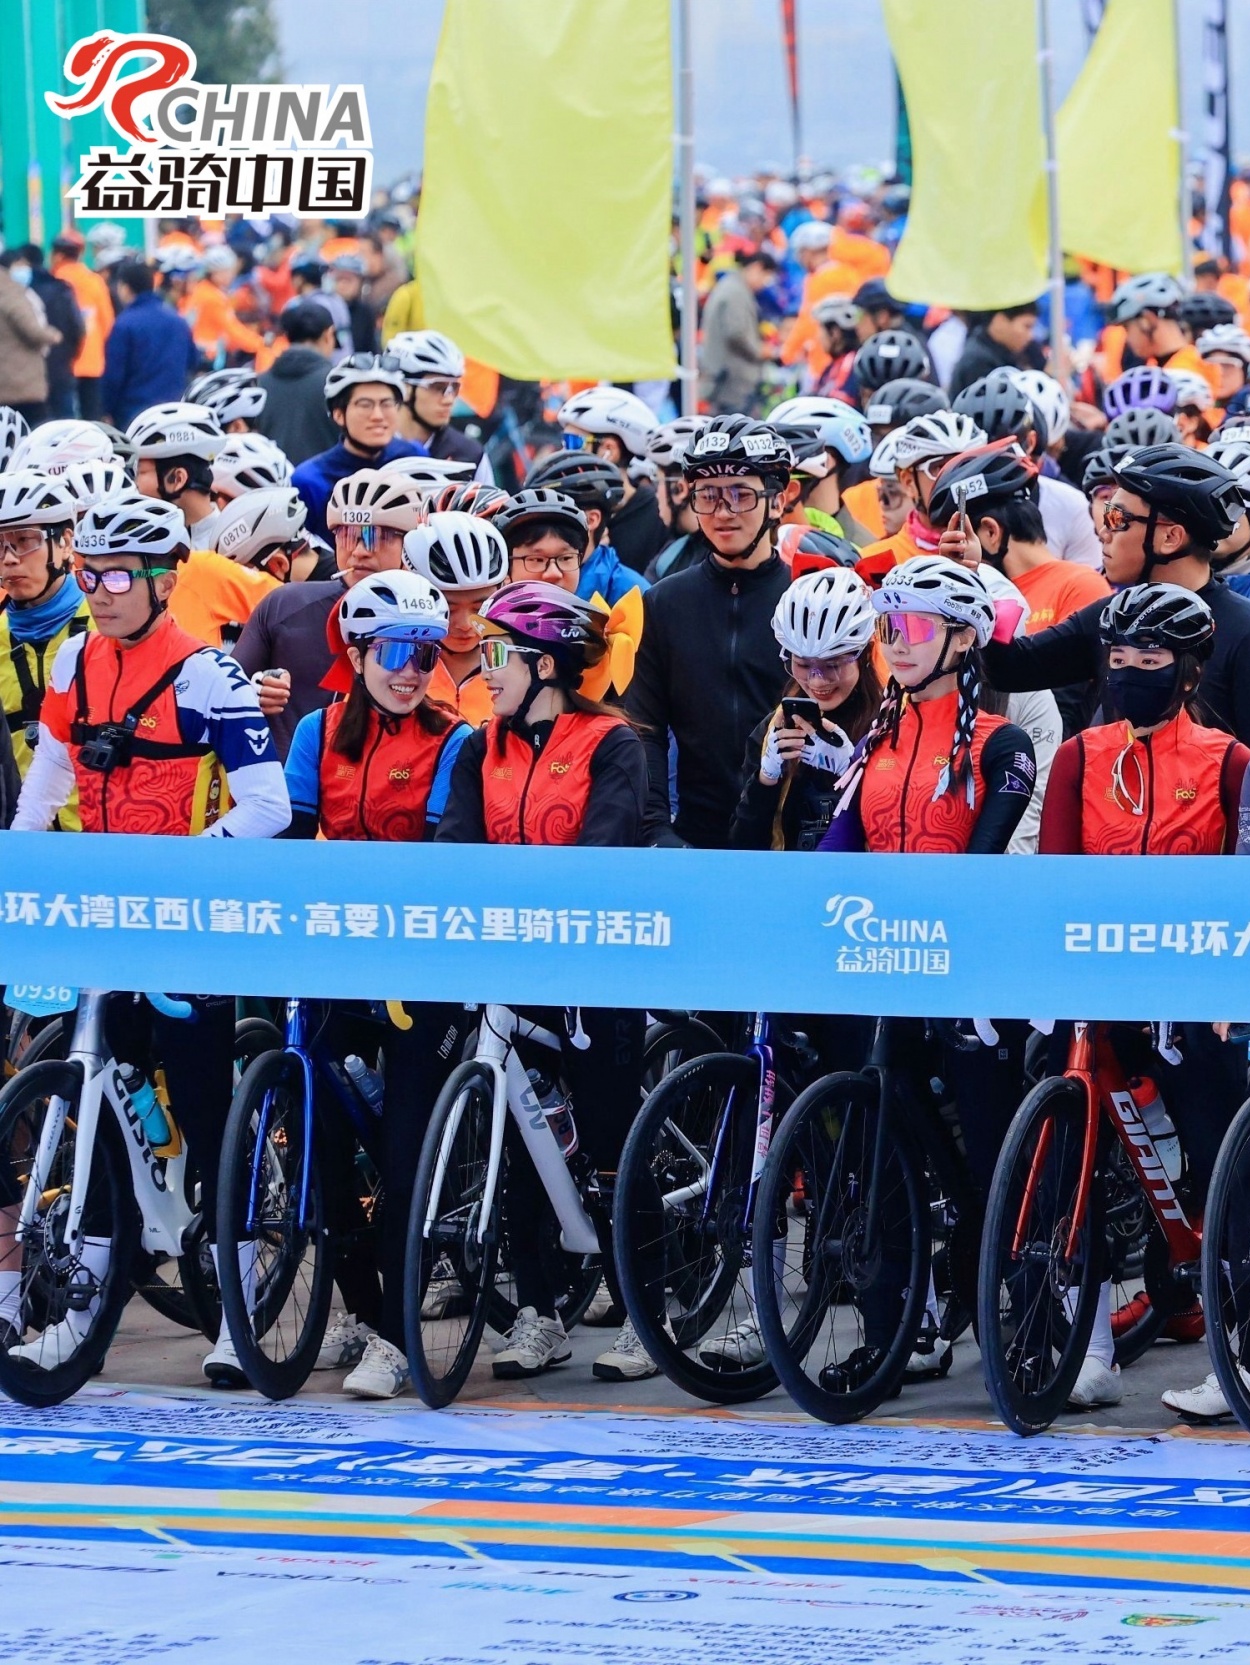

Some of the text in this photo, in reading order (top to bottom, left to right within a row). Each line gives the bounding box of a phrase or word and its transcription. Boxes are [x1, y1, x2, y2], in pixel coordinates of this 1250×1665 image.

[169, 432, 195, 443] 0881
[699, 436, 727, 451] 0132
[747, 439, 773, 451] 0132
[343, 511, 371, 523] 1302
[223, 524, 247, 547] 0870
[402, 598, 433, 610] 1463
[561, 629, 580, 638] Liv
[835, 946, 949, 976] 益骑中国
[1108, 1090, 1192, 1230] GIANT
